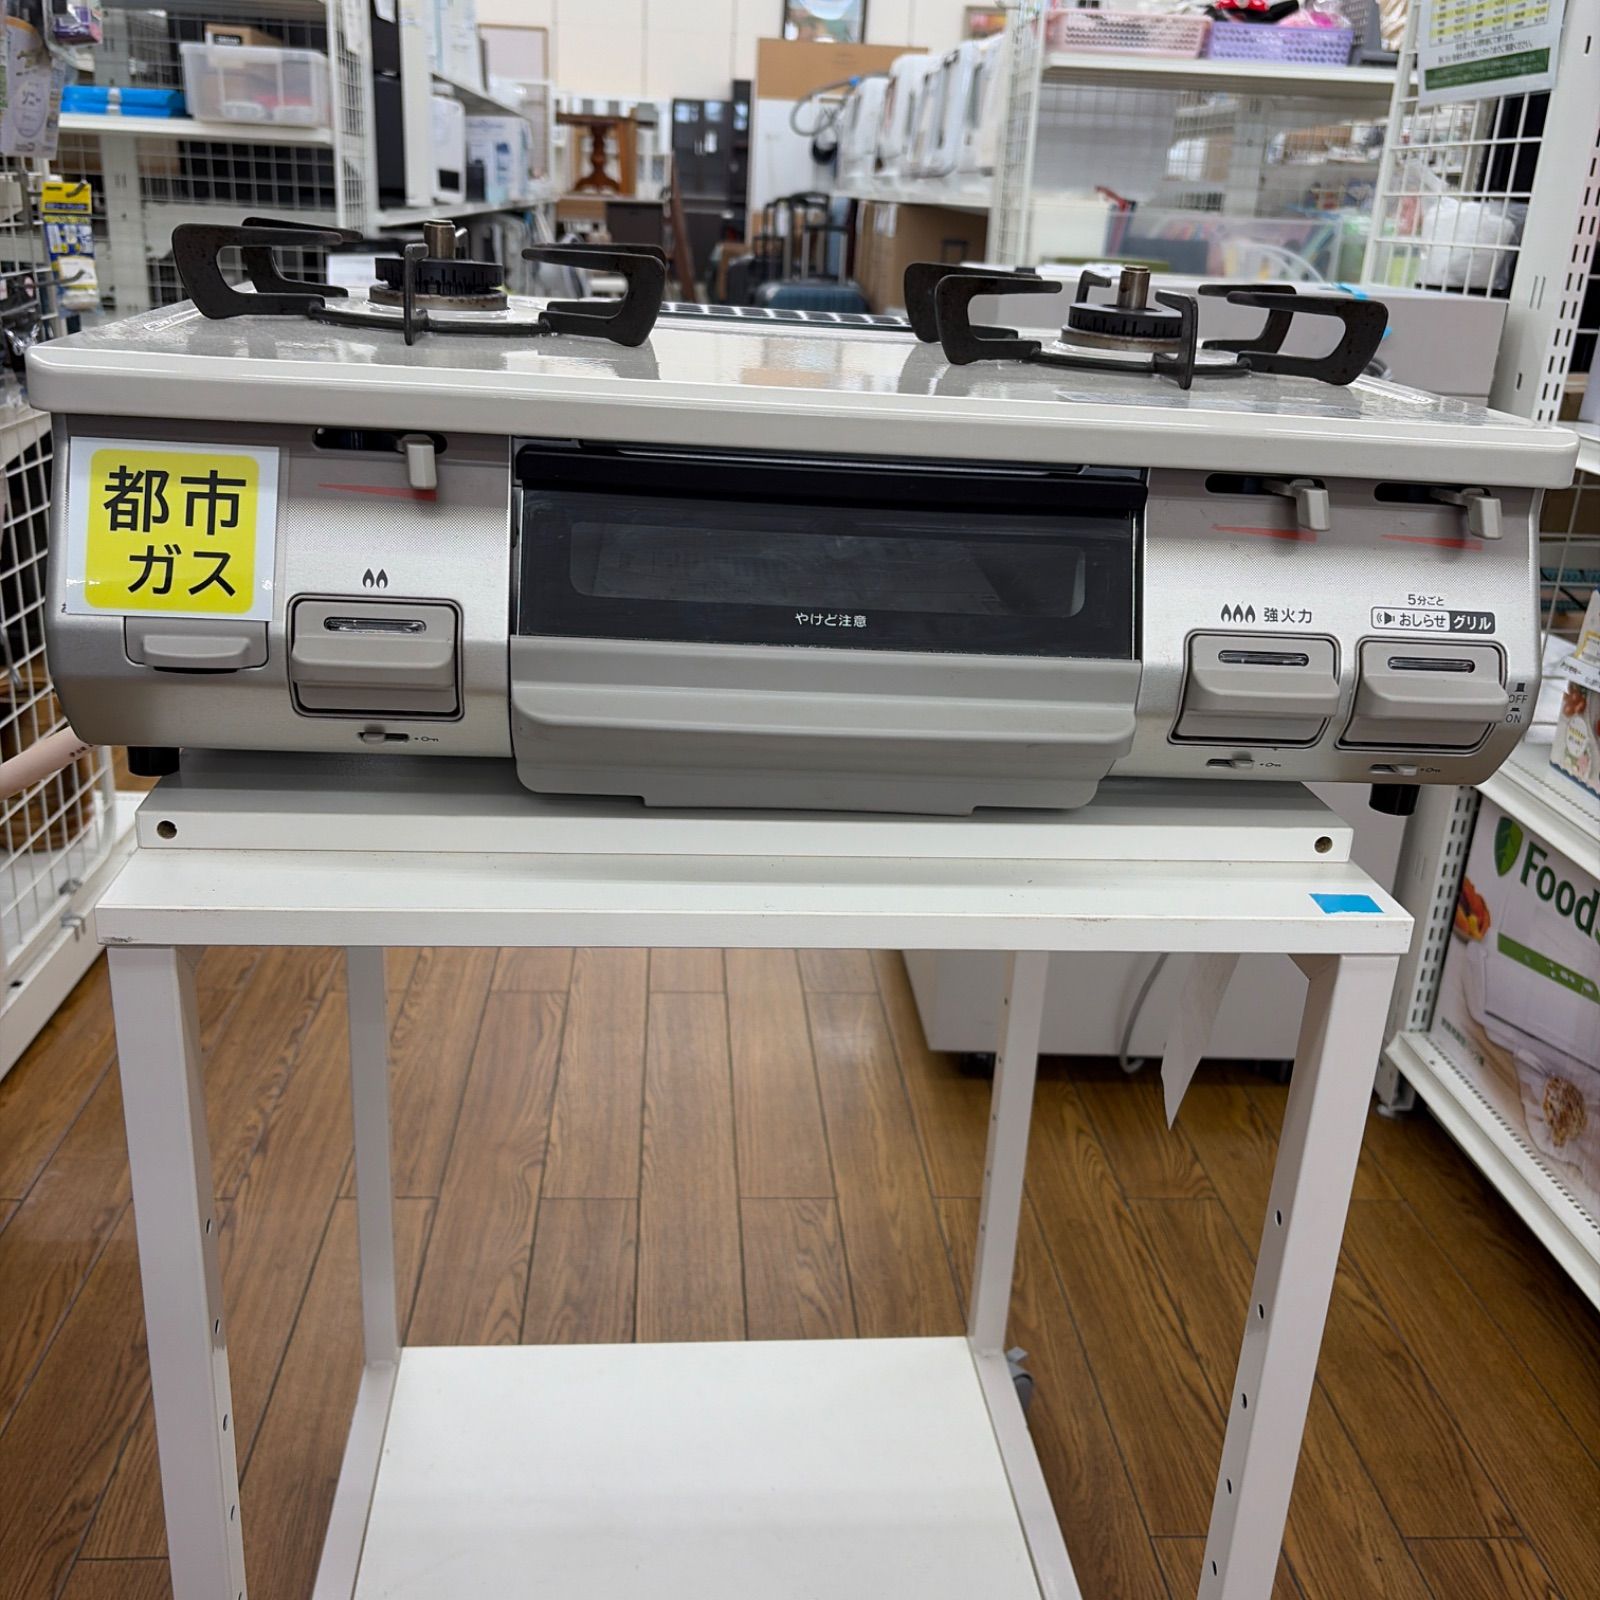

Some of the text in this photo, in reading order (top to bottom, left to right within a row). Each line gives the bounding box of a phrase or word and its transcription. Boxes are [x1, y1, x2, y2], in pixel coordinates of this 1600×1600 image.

[103, 465, 247, 536] 都市
[127, 543, 236, 597] ガス
[1407, 593, 1445, 607] 5分ごと
[794, 612, 868, 628] やけど注意
[1263, 607, 1313, 625] 強火力
[1399, 612, 1493, 631] おしらせ グリル
[1508, 694, 1529, 704] OFF
[1505, 713, 1522, 724] ON
[1520, 840, 1600, 946] Food
